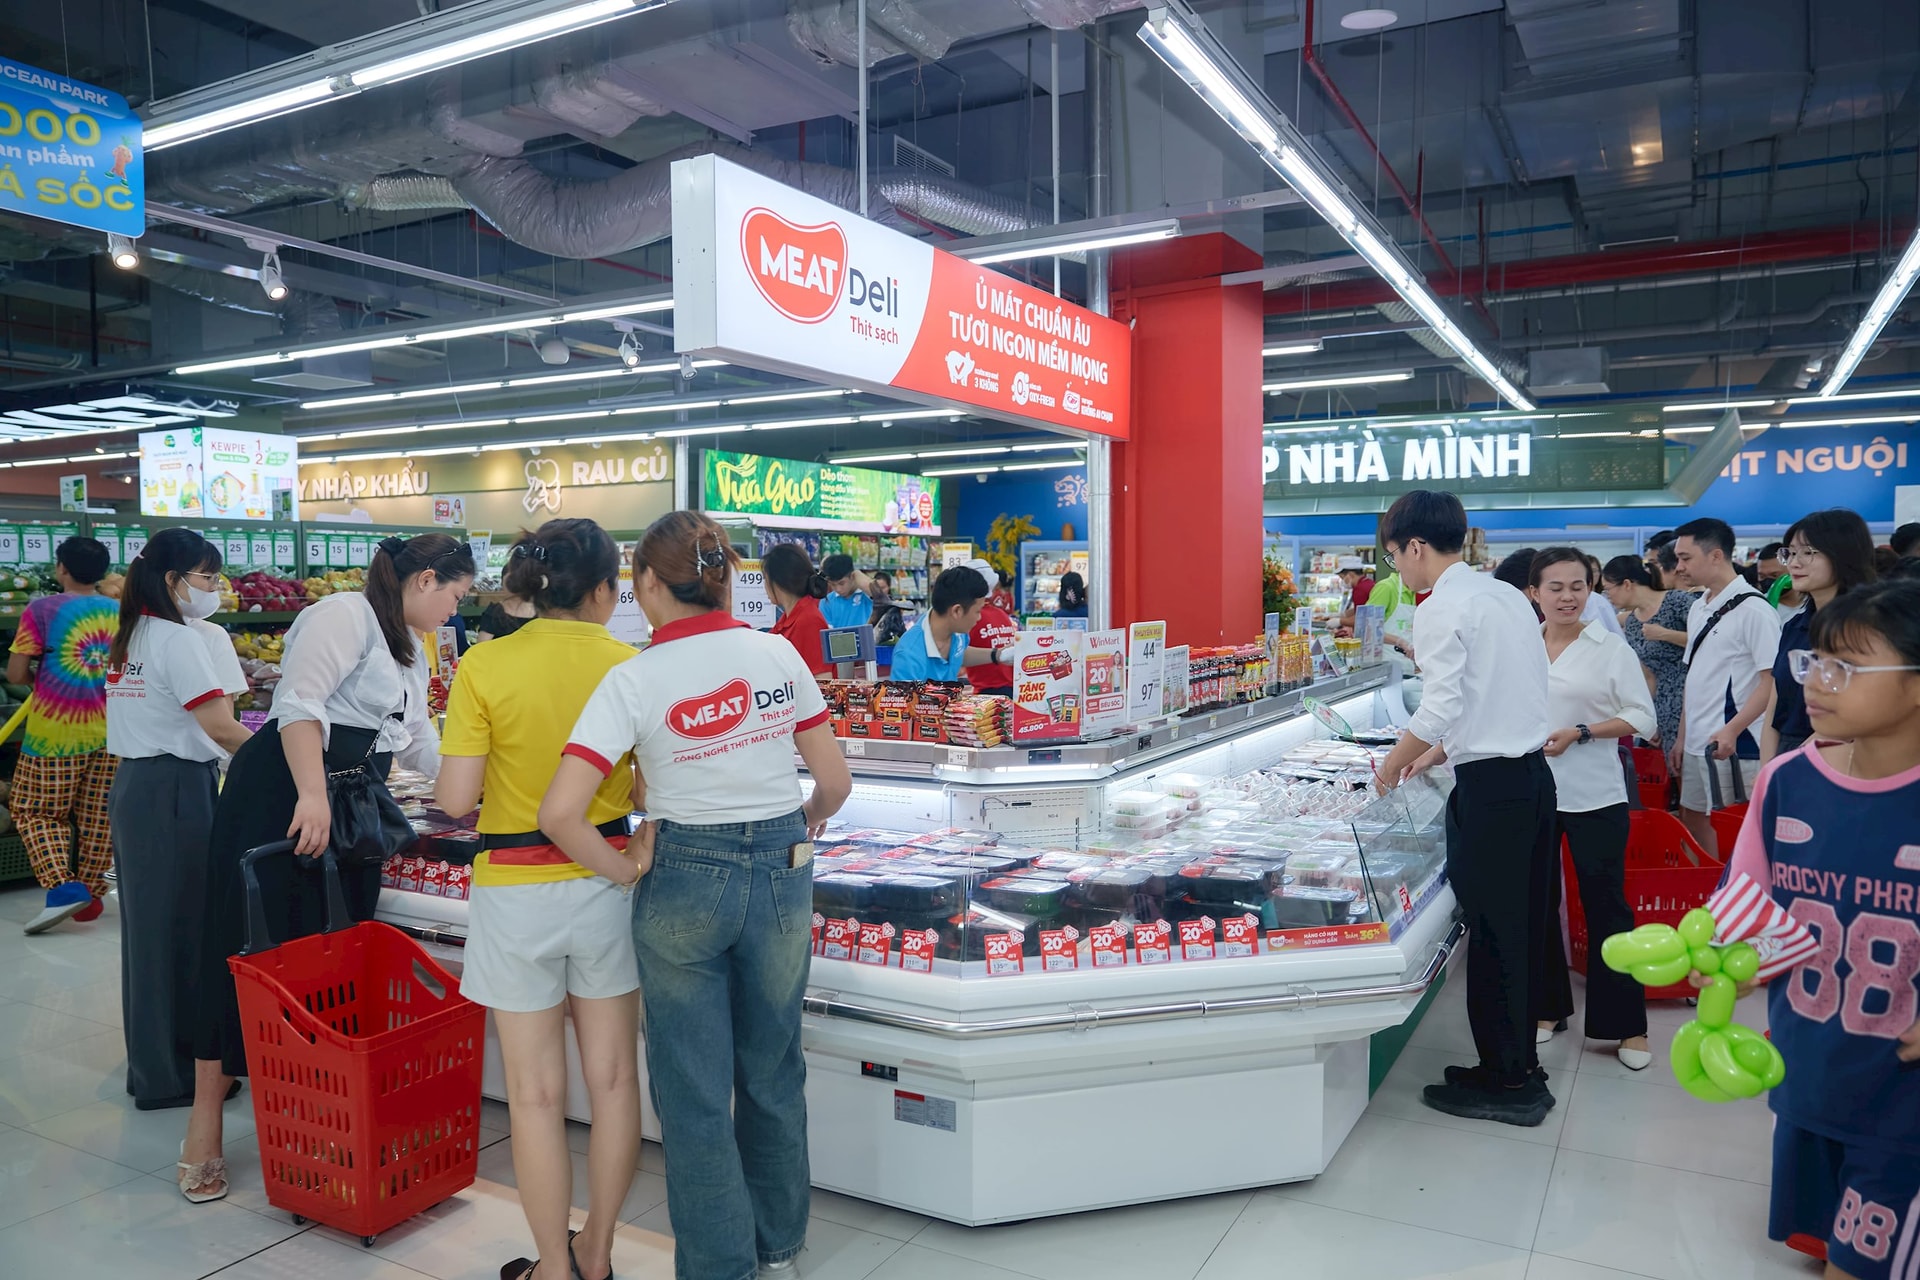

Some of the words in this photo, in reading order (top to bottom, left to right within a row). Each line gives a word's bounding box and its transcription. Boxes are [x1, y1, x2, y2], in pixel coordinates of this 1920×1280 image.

[0, 63, 57, 91] CEAN
[59, 82, 109, 107] PARK
[27, 143, 95, 169] phẩm
[36, 169, 135, 211] SỐC
[760, 234, 838, 297] MEAT
[850, 267, 898, 318] Deli
[976, 275, 987, 310] Ủ
[990, 288, 1022, 323] MÁT
[1024, 300, 1071, 341] CHUẨN
[1073, 316, 1091, 347] ÂU
[850, 316, 872, 341] Thịt
[875, 327, 899, 345] sạch
[949, 311, 989, 349] TƯƠI
[993, 325, 1035, 363] NGON
[1038, 339, 1069, 373] MỀM
[1071, 353, 1108, 385] MỌNG
[211, 440, 247, 454] KEWPIE
[1289, 429, 1390, 485] NHÀ
[1402, 424, 1531, 481] MÌNH
[572, 457, 624, 486] RAU
[631, 446, 667, 482] CỦ
[1720, 451, 1766, 483] ỊT
[1776, 436, 1907, 477] NGUỘI
[312, 470, 367, 504] NHẬP
[371, 458, 429, 497] KHẨU
[765, 461, 815, 514] Gạo
[0, 538, 10, 550] 0
[27, 539, 41, 549] 55
[128, 541, 140, 551] 19
[229, 543, 242, 553] 25
[255, 544, 266, 553] 26
[277, 545, 288, 553] 29
[311, 544, 319, 557] 5
[332, 545, 342, 554] 15
[740, 573, 763, 585] 499
[617, 592, 634, 604] 69
[740, 601, 763, 613] 199
[1089, 636, 1120, 649] WinMart
[1143, 642, 1155, 659] 44
[1025, 659, 1048, 669] 150K
[754, 681, 794, 710] Deli
[1018, 692, 1046, 703] NGAY
[1141, 683, 1154, 701] 97
[681, 695, 744, 730] MEAT
[760, 710, 780, 722] Thịt
[673, 753, 702, 763] CÔNG
[703, 744, 729, 758] NGHỆ
[730, 739, 750, 751] THỊT
[751, 732, 769, 744] MÁT
[1359, 929, 1381, 941] 36%
[1787, 897, 1920, 1039] 88
[1834, 1186, 1898, 1261] 88
